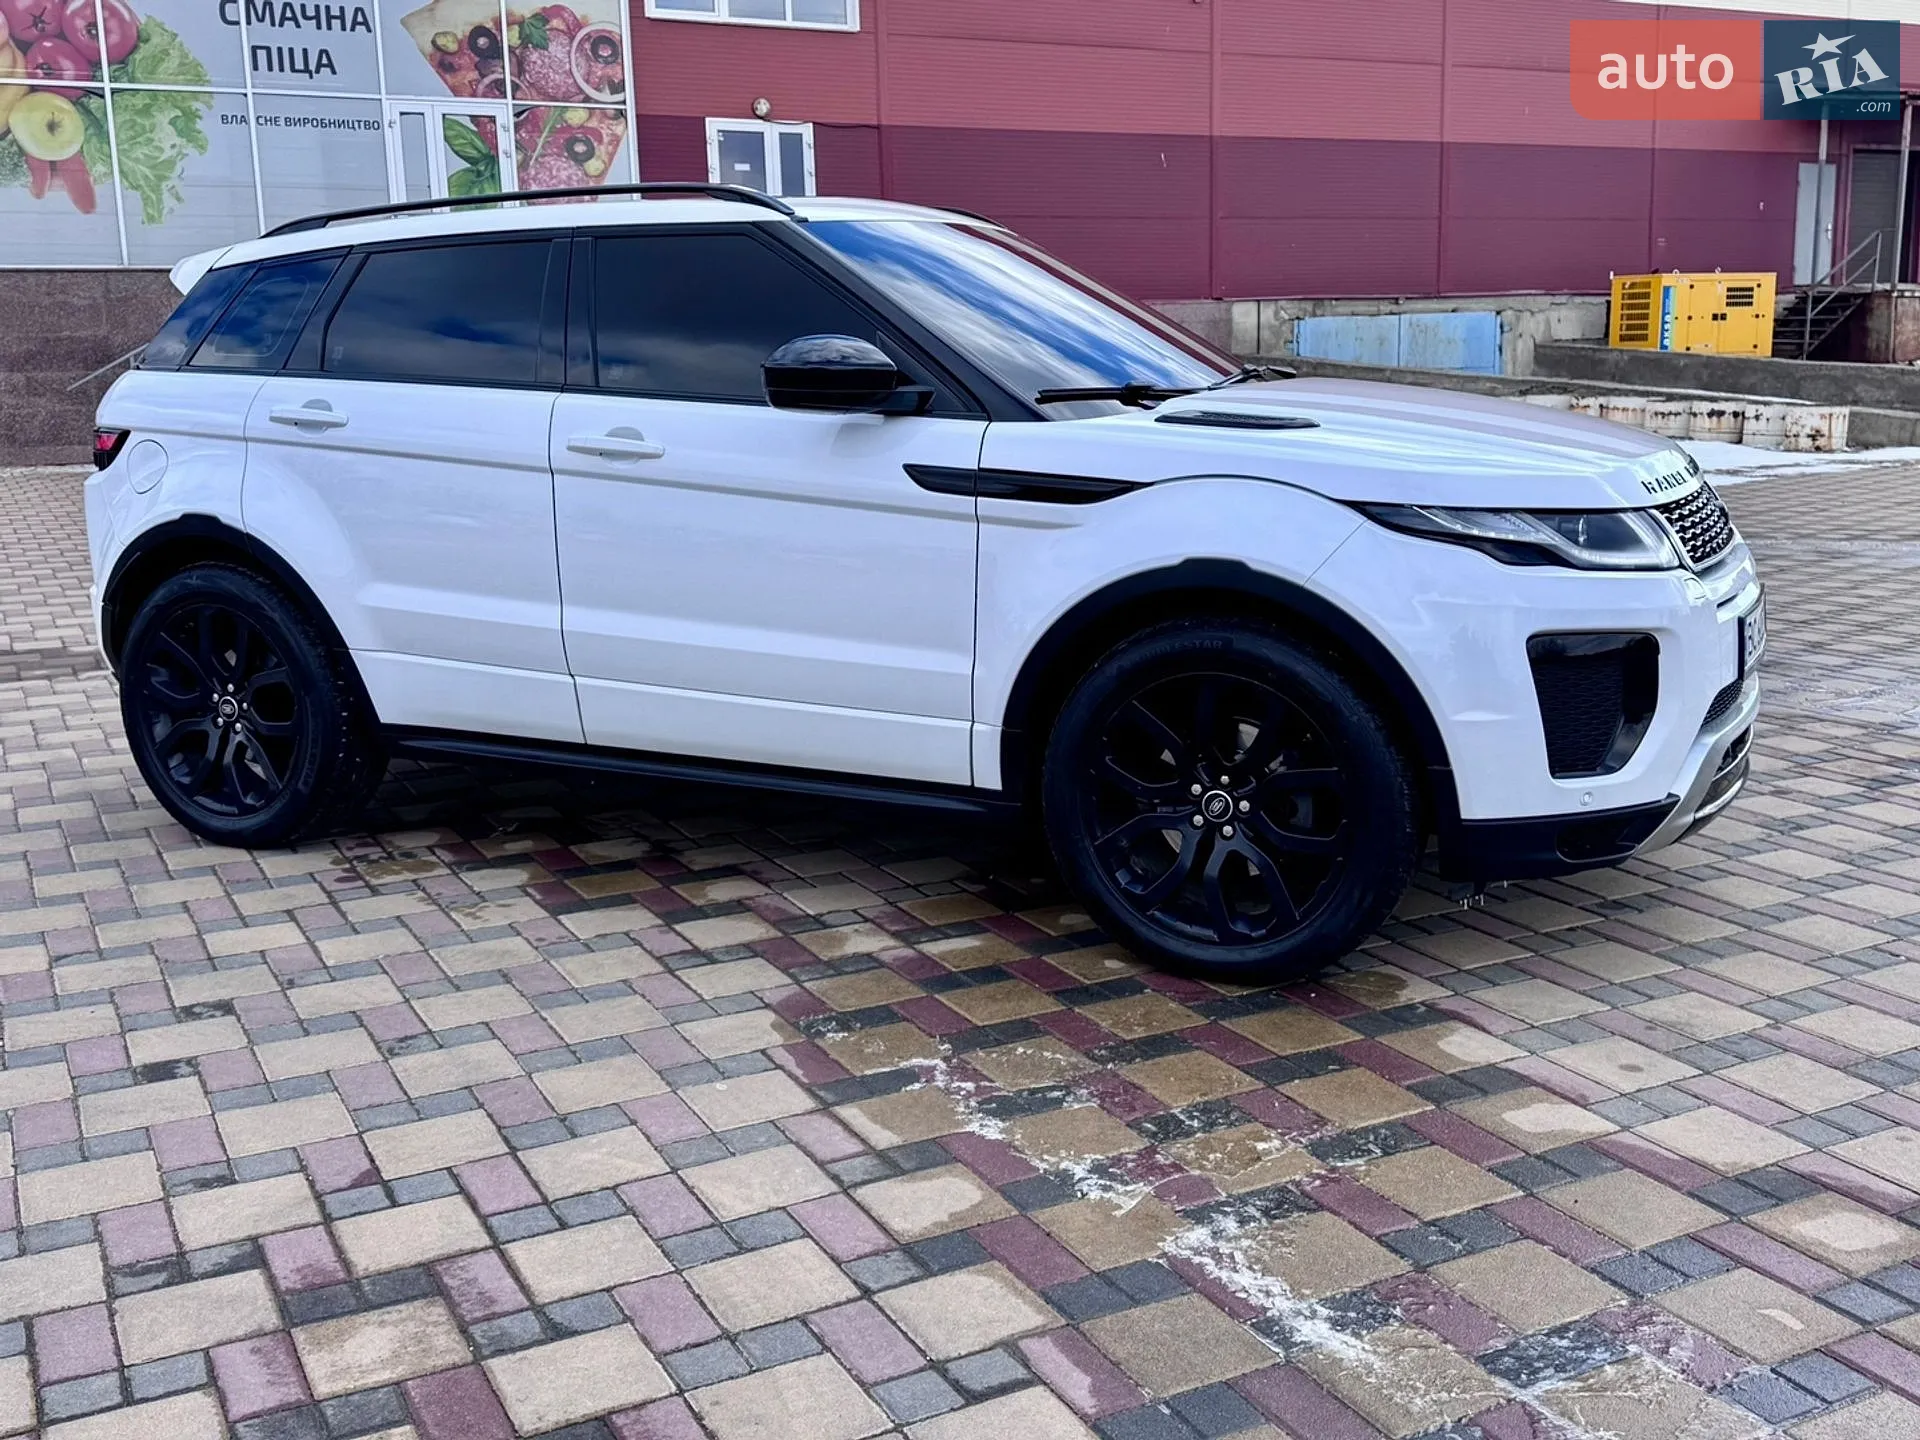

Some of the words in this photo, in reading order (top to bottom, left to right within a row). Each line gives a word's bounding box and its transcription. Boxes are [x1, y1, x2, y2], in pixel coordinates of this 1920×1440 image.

[219, 0, 373, 33] СМАЧНА
[251, 45, 337, 80] ПІЦА
[284, 116, 381, 131] ВИРОБНИЦТВО
